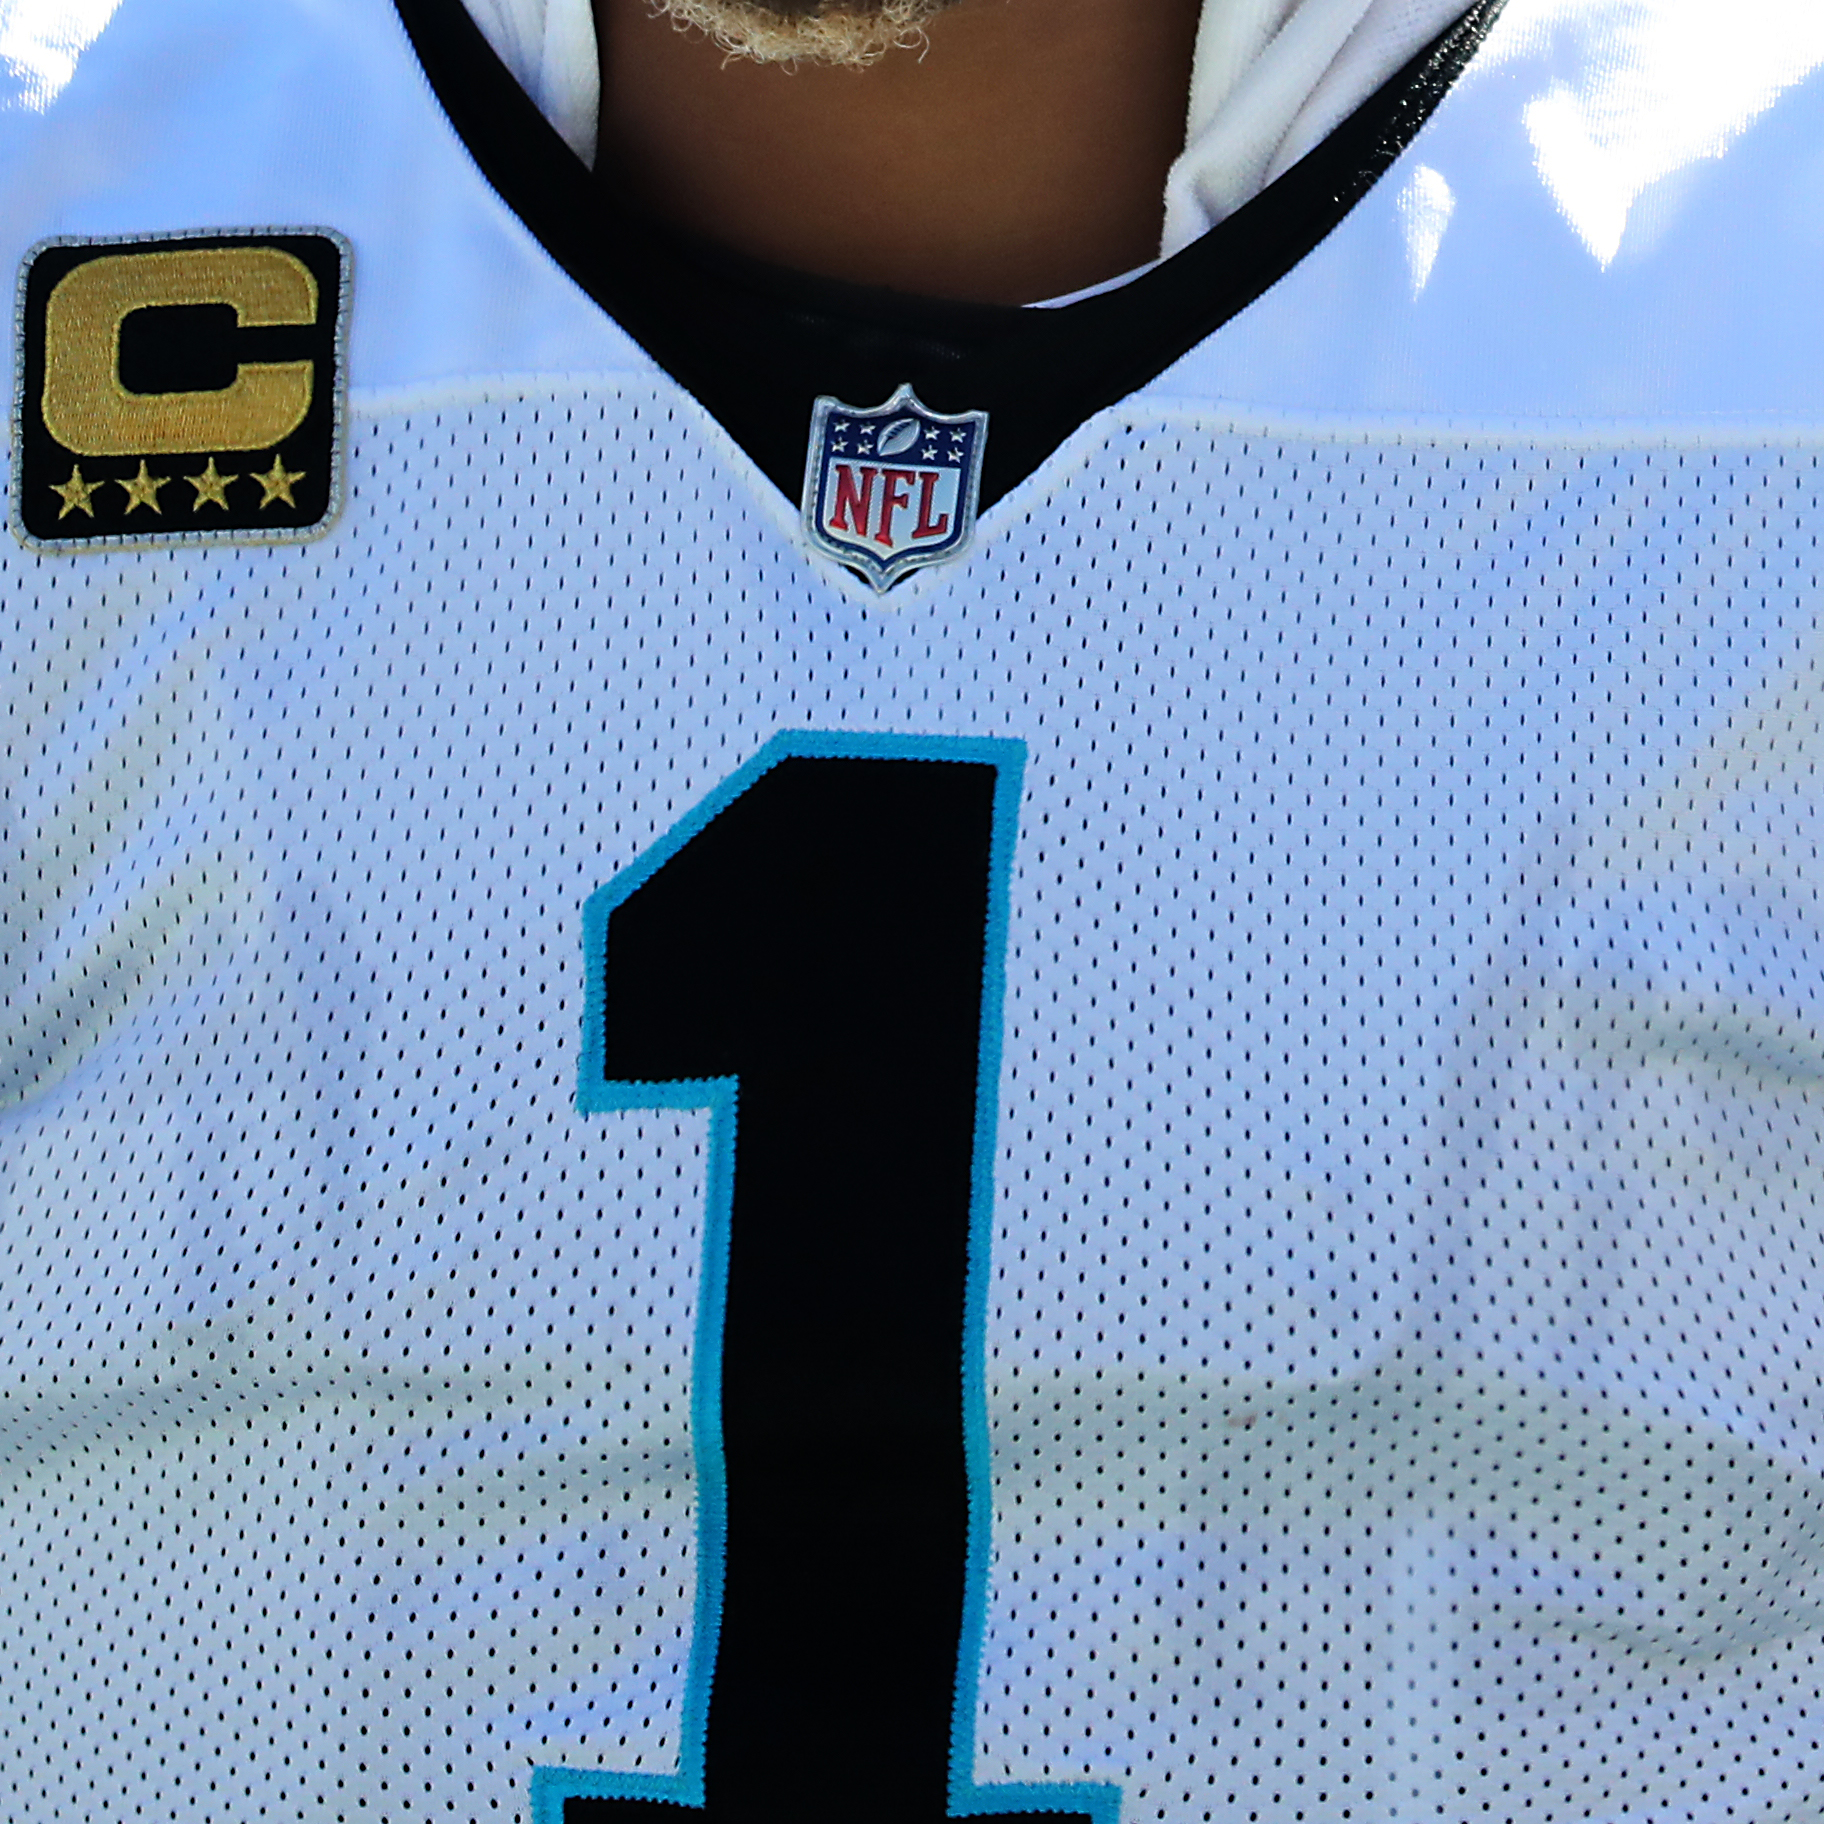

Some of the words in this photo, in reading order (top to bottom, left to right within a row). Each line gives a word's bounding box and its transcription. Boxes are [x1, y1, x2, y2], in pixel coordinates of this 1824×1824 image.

[42, 247, 317, 456] C
[829, 464, 948, 547] NFL
[530, 729, 1122, 1824] 1
